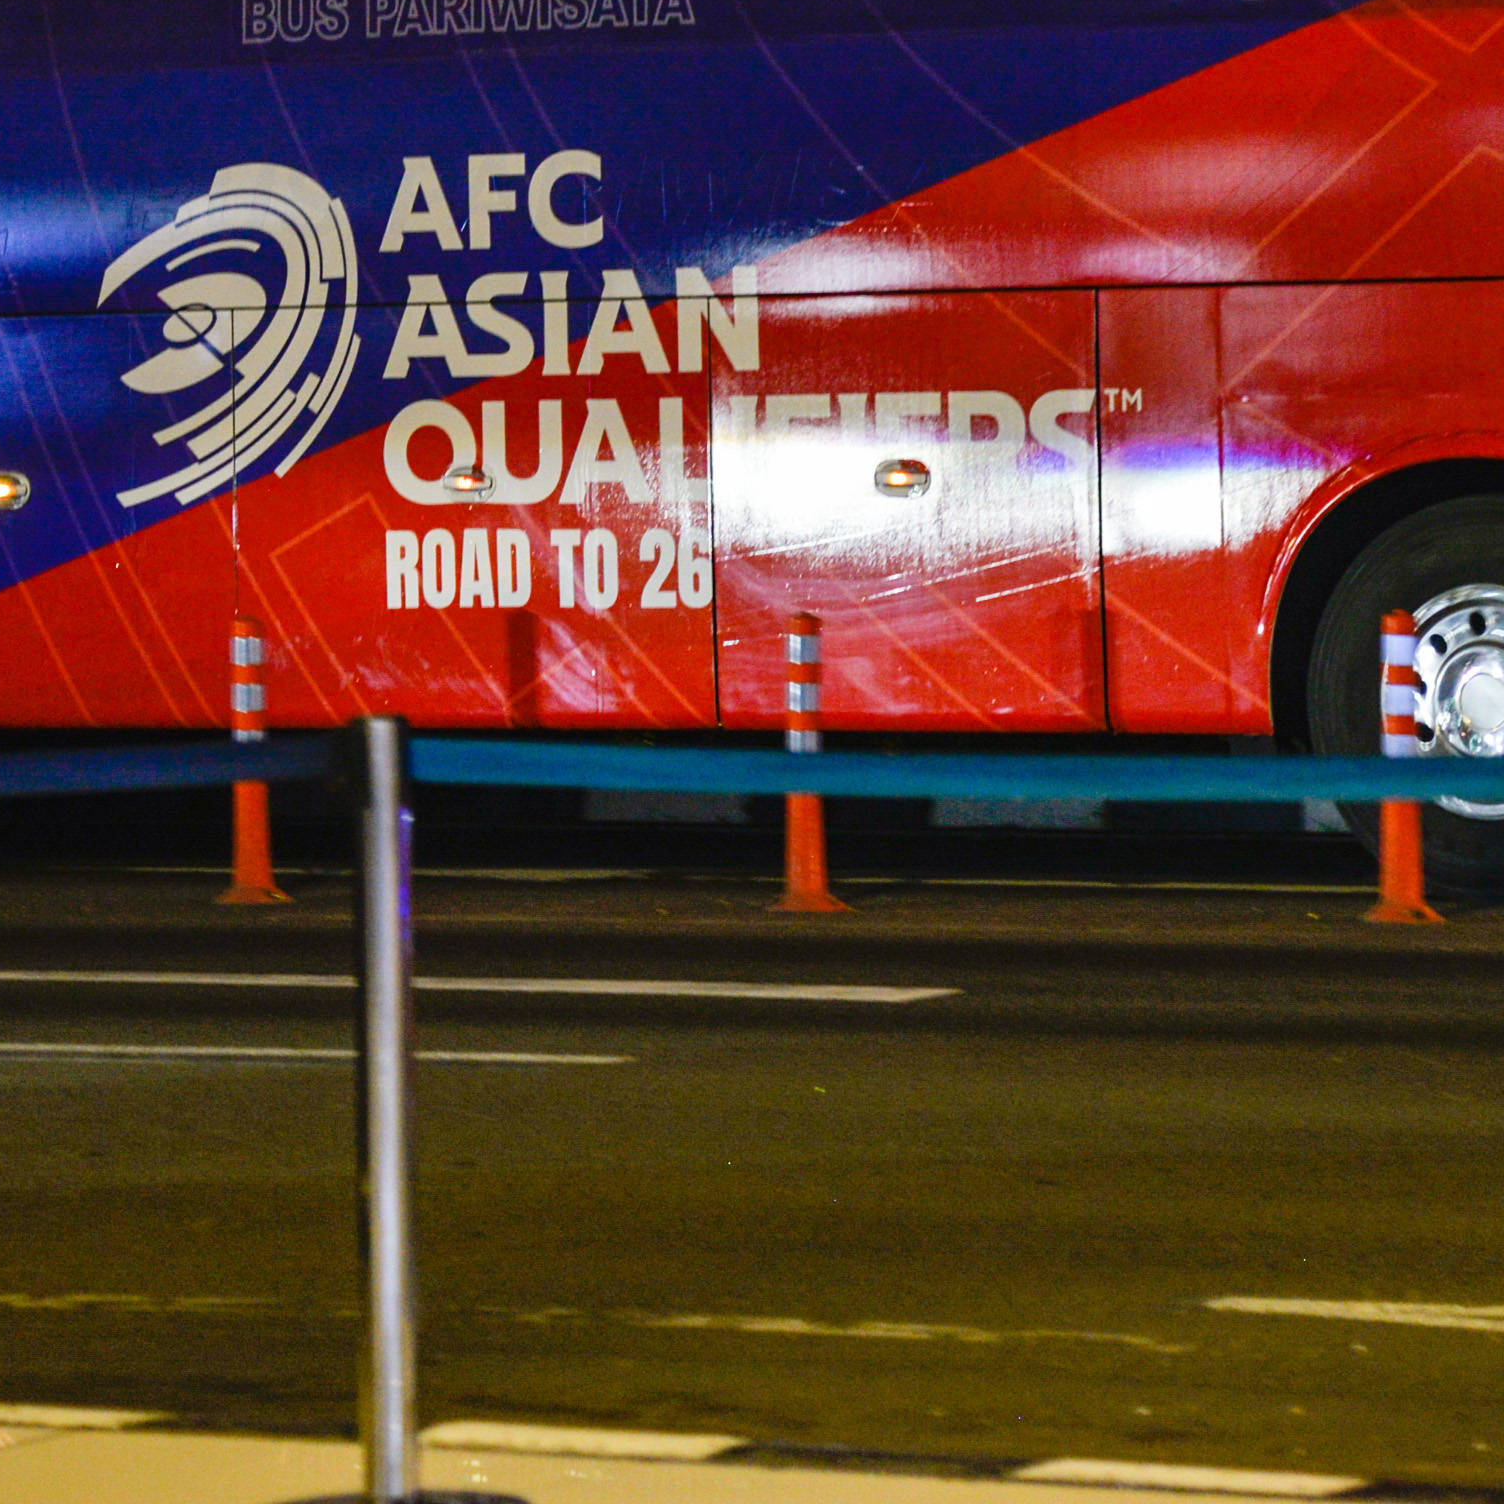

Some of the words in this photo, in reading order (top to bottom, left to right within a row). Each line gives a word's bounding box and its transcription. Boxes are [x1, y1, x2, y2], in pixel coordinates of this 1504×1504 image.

[379, 149, 604, 253] AFC
[381, 266, 759, 379] ASIAN
[386, 528, 532, 610] ROAD
[551, 529, 620, 610] TO
[641, 527, 713, 608] 26
